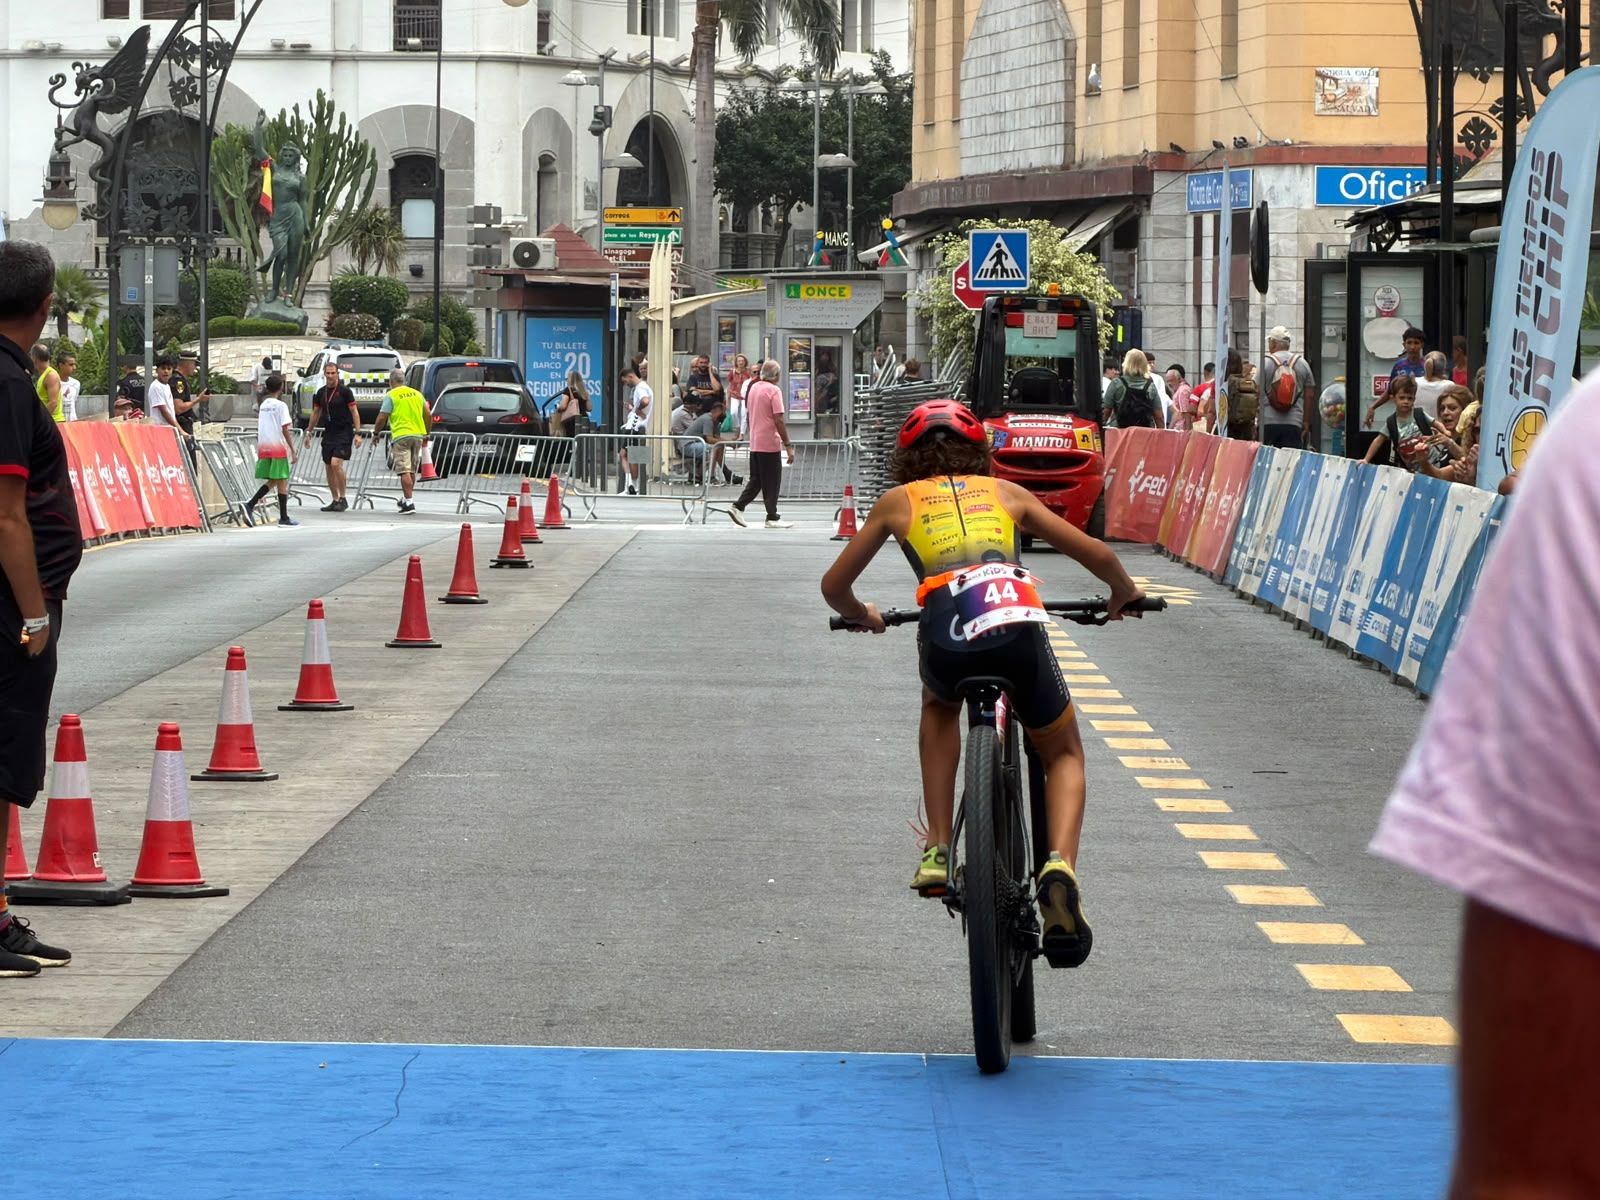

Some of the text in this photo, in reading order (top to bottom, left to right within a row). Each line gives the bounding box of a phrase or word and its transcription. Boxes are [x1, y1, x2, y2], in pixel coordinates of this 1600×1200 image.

[639, 231, 660, 240] Reyes
[824, 231, 855, 247] MANG
[1533, 150, 1570, 336] CHIP
[604, 249, 636, 257] sinagoga
[1508, 147, 1546, 401] MIS TIEMPOS
[805, 286, 847, 297] ONCE
[541, 342, 588, 350] TU BILLETE
[533, 361, 562, 369] BARCO
[564, 351, 592, 379] 20
[399, 391, 416, 399] STAFF
[1011, 436, 1073, 448] MANITOU
[983, 580, 1019, 605] 44
